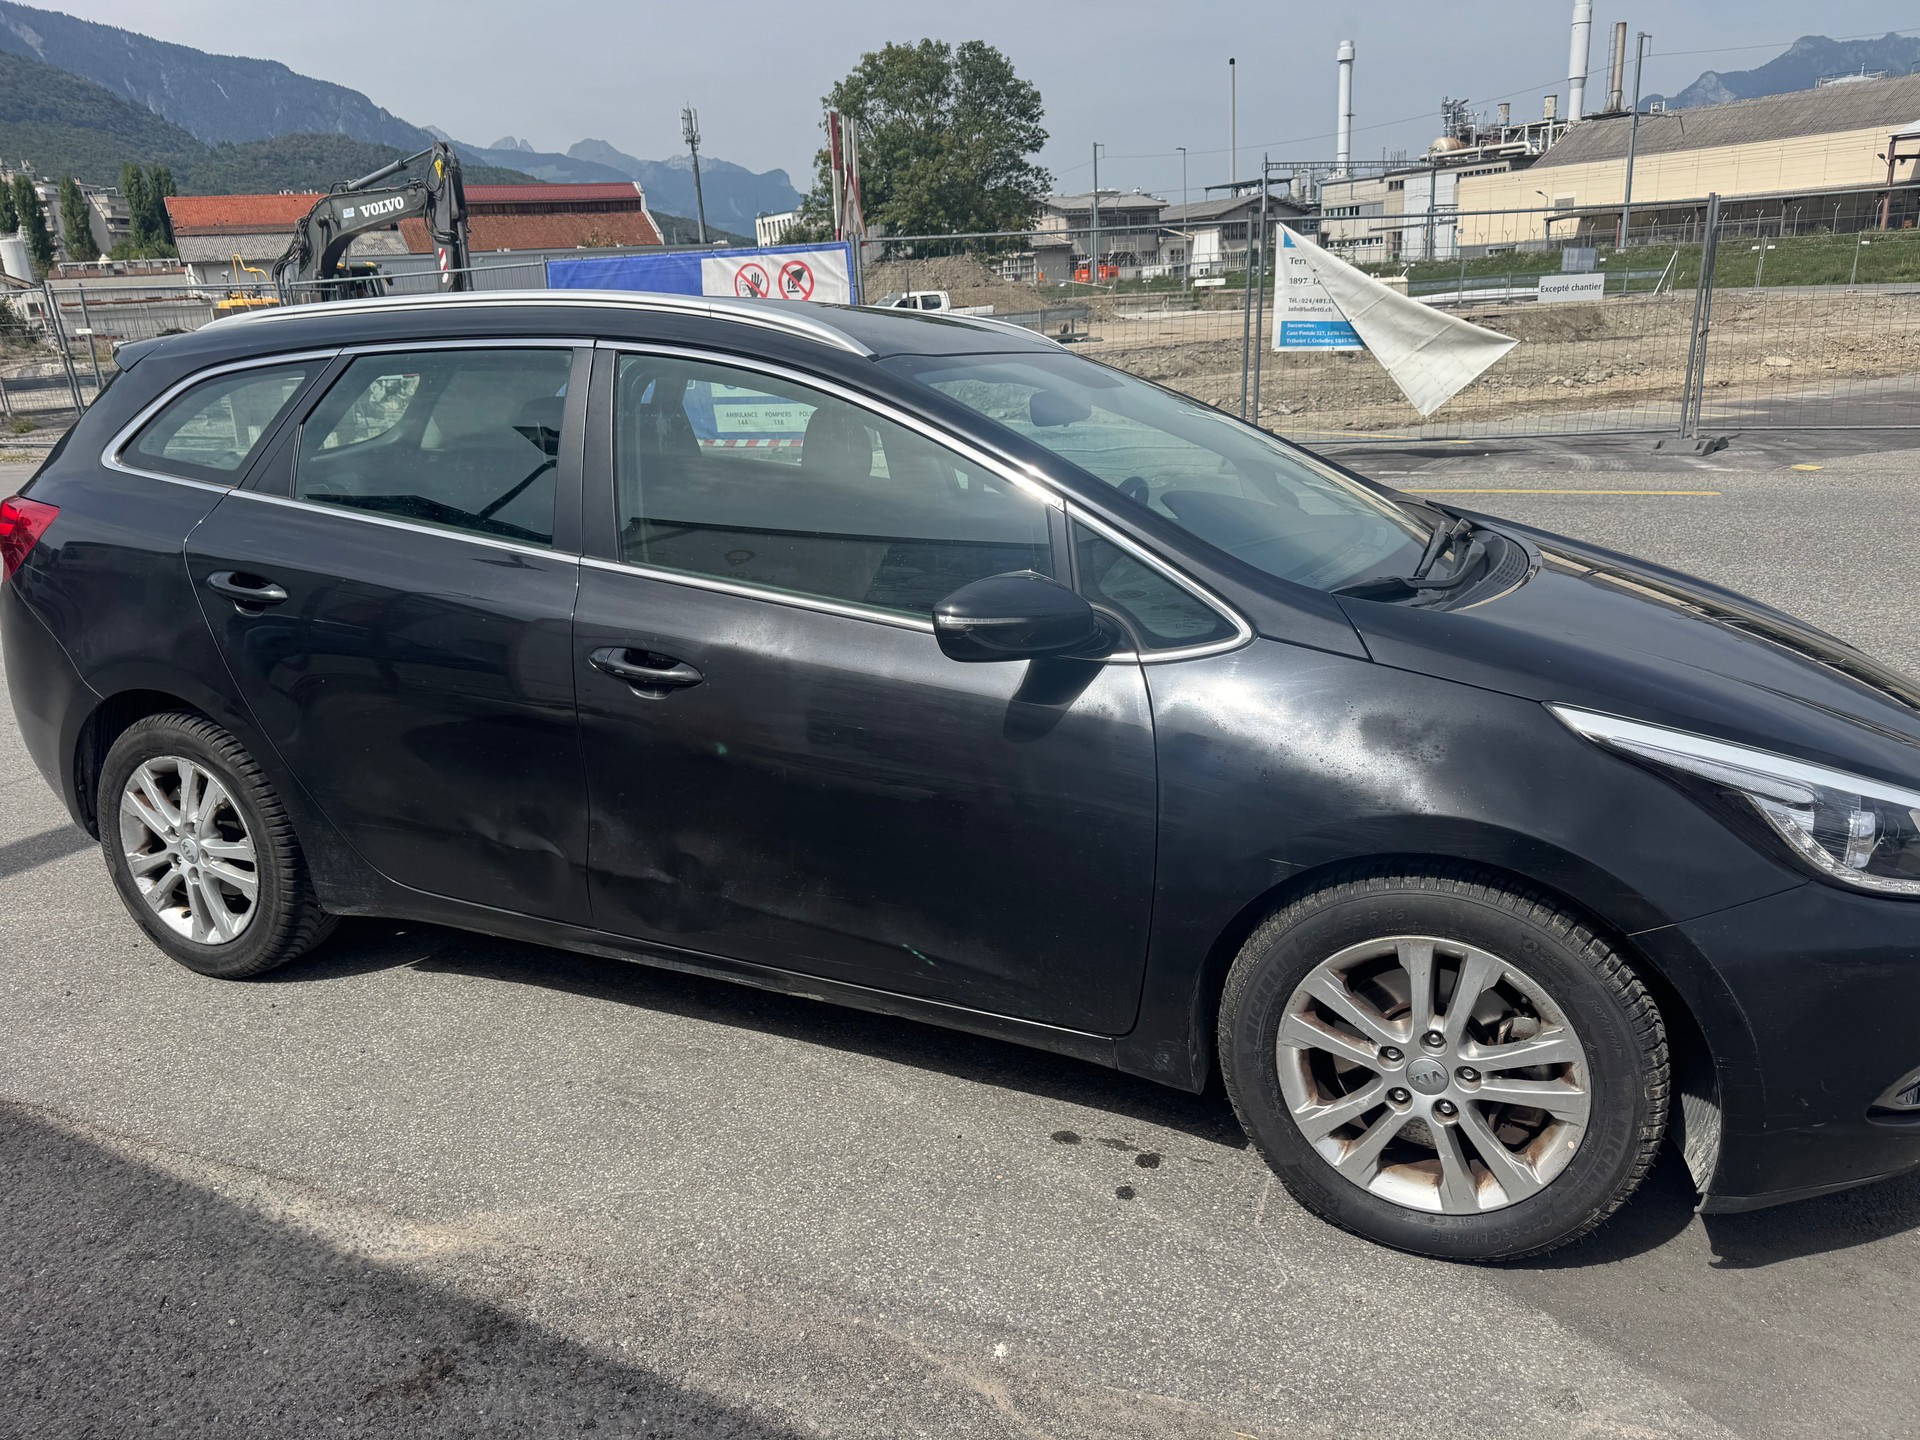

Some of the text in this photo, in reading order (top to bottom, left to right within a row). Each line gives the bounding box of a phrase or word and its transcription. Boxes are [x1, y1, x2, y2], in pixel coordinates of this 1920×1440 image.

[359, 196, 405, 218] VOLVO
[1289, 277, 1307, 285] 1897
[1540, 282, 1602, 294] Excepté chantier
[181, 841, 195, 863] KIA
[1409, 1069, 1446, 1088] KIA
